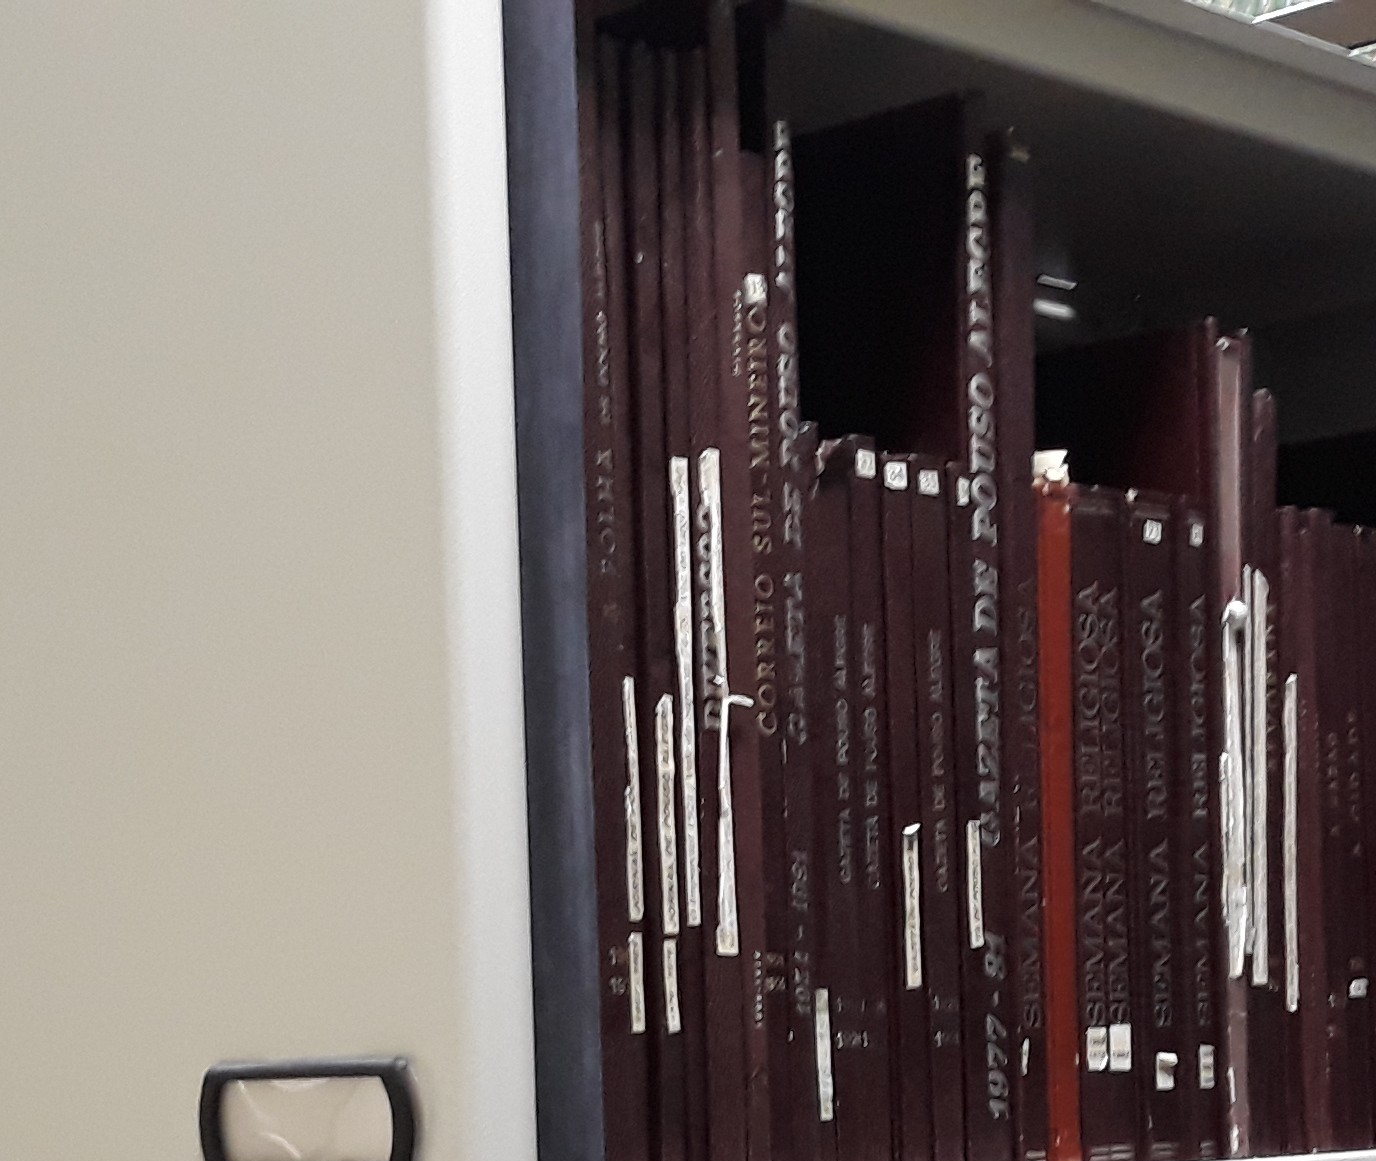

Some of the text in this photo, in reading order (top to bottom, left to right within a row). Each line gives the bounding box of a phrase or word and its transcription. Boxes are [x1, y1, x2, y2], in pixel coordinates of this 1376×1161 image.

[966, 152, 994, 368] ALEGRE
[969, 372, 998, 548] POUSO
[753, 573, 778, 737] CORREIO
[970, 556, 999, 637] DE
[1077, 580, 1102, 814] RELIGIOSA
[1140, 588, 1172, 1028] SEMANA RELIGIOSA
[1017, 833, 1042, 1029] SEMANA
[1082, 836, 1107, 1025] SEMANA
[1103, 837, 1130, 1024] SEMANA
[1191, 842, 1212, 1027] SEMANA
[984, 1013, 1009, 1121] 1977
